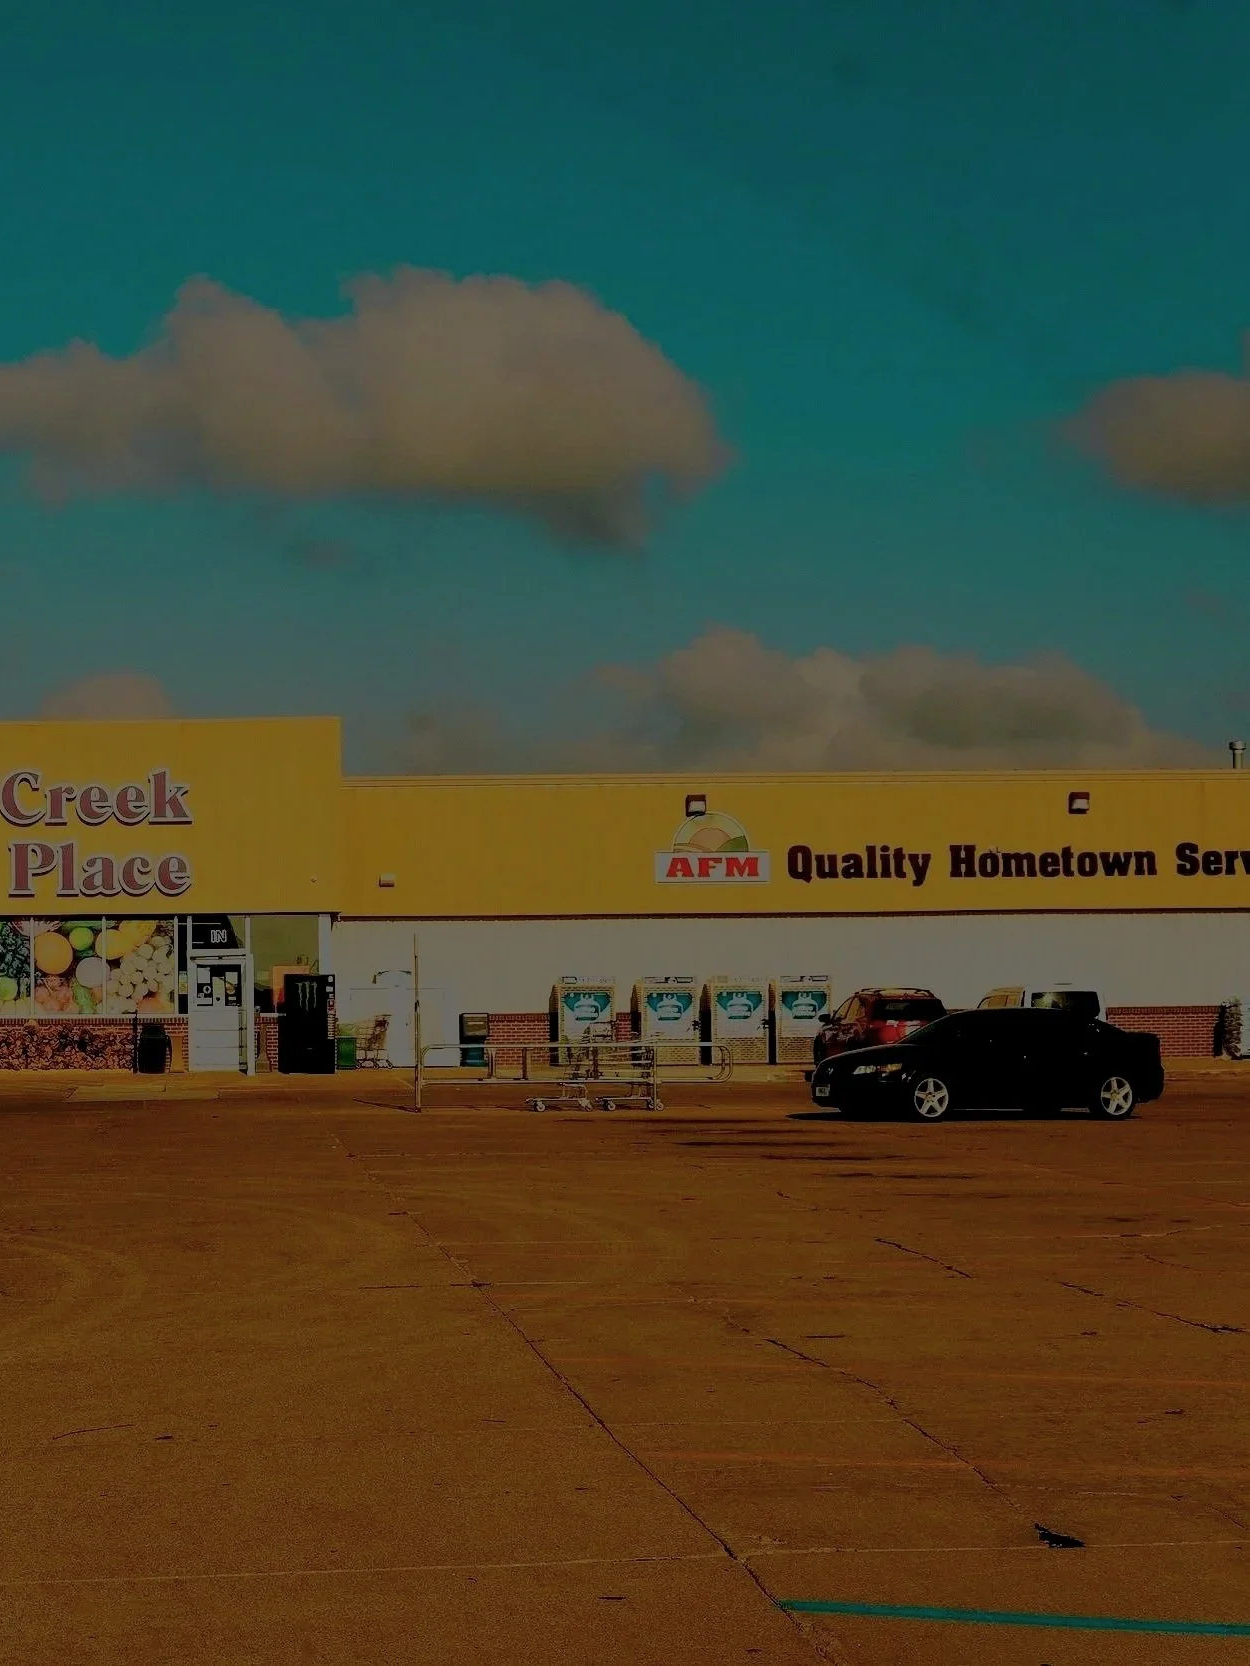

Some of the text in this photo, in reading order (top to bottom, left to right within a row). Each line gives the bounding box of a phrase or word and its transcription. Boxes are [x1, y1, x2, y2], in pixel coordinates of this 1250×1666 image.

[7, 839, 191, 896] Place
[666, 857, 759, 877] AFM
[787, 845, 931, 886] Quality
[949, 844, 1157, 877] Hometown
[210, 929, 228, 943] IN
